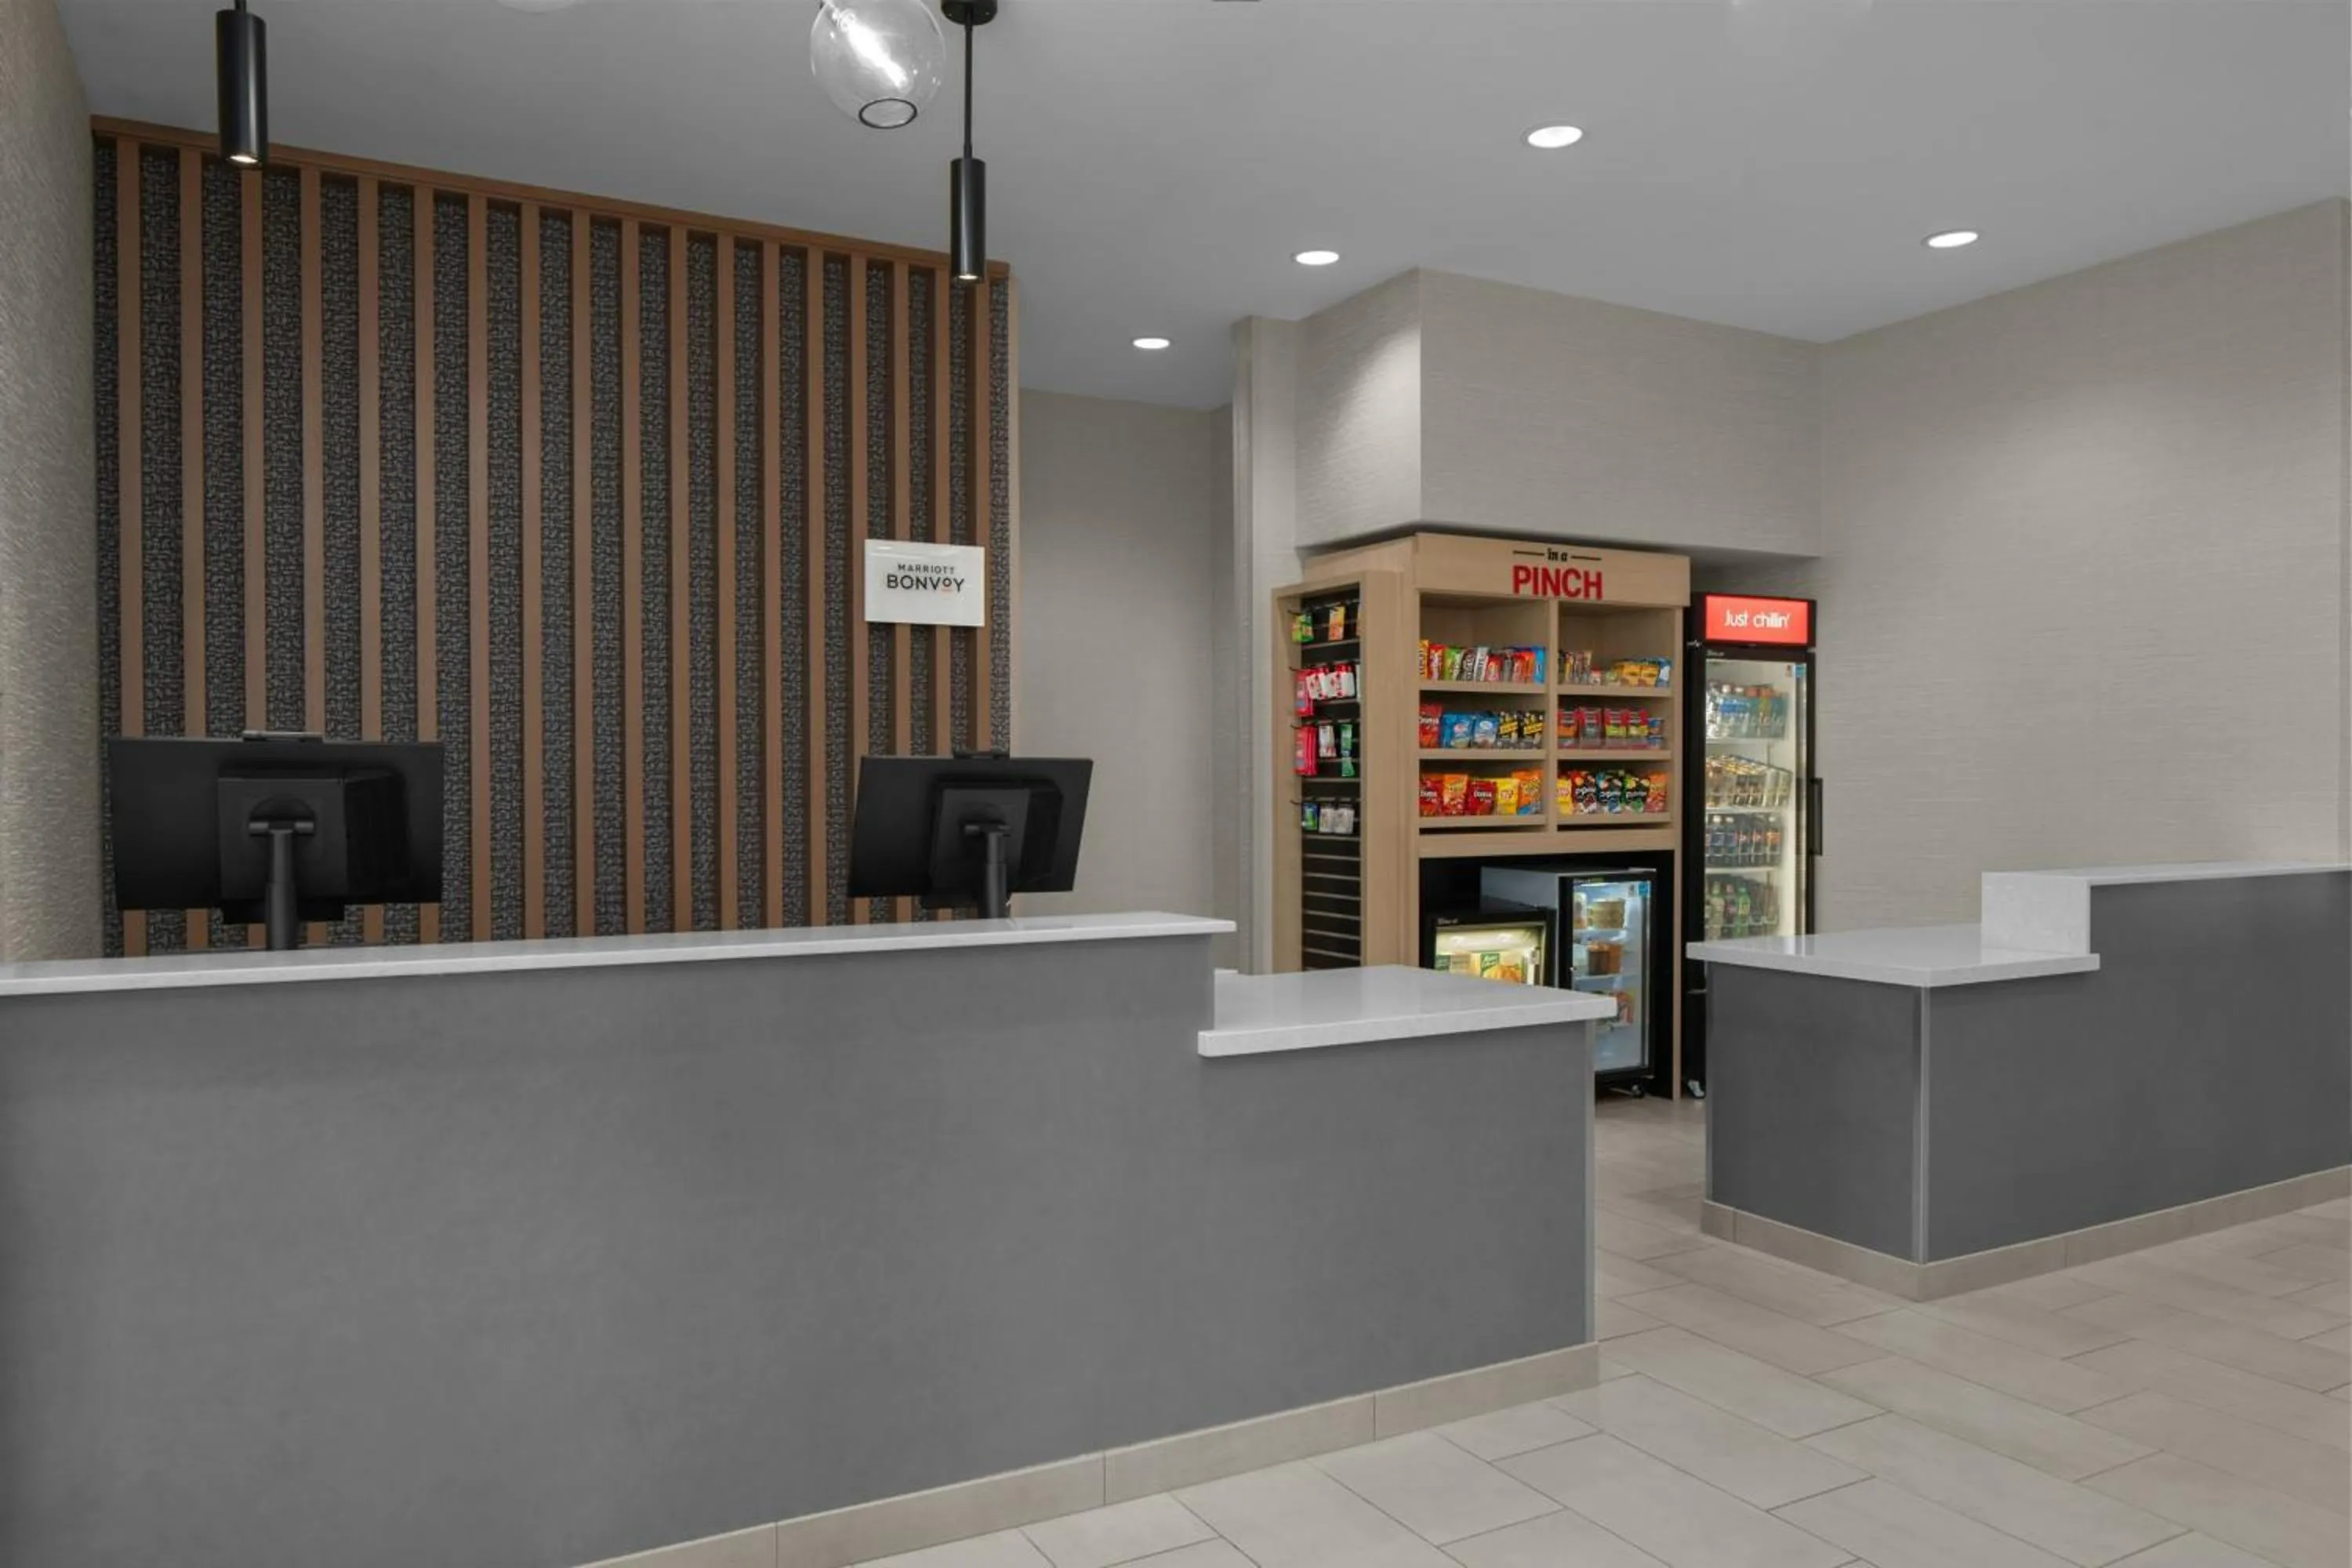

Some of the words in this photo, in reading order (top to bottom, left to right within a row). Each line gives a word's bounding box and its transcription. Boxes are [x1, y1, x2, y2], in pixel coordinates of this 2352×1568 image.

[1548, 548, 1558, 561] in
[1561, 552, 1567, 561] a
[898, 564, 955, 574] MARRIOTT
[887, 574, 965, 592] BONVOY
[1513, 564, 1603, 601] PINCH
